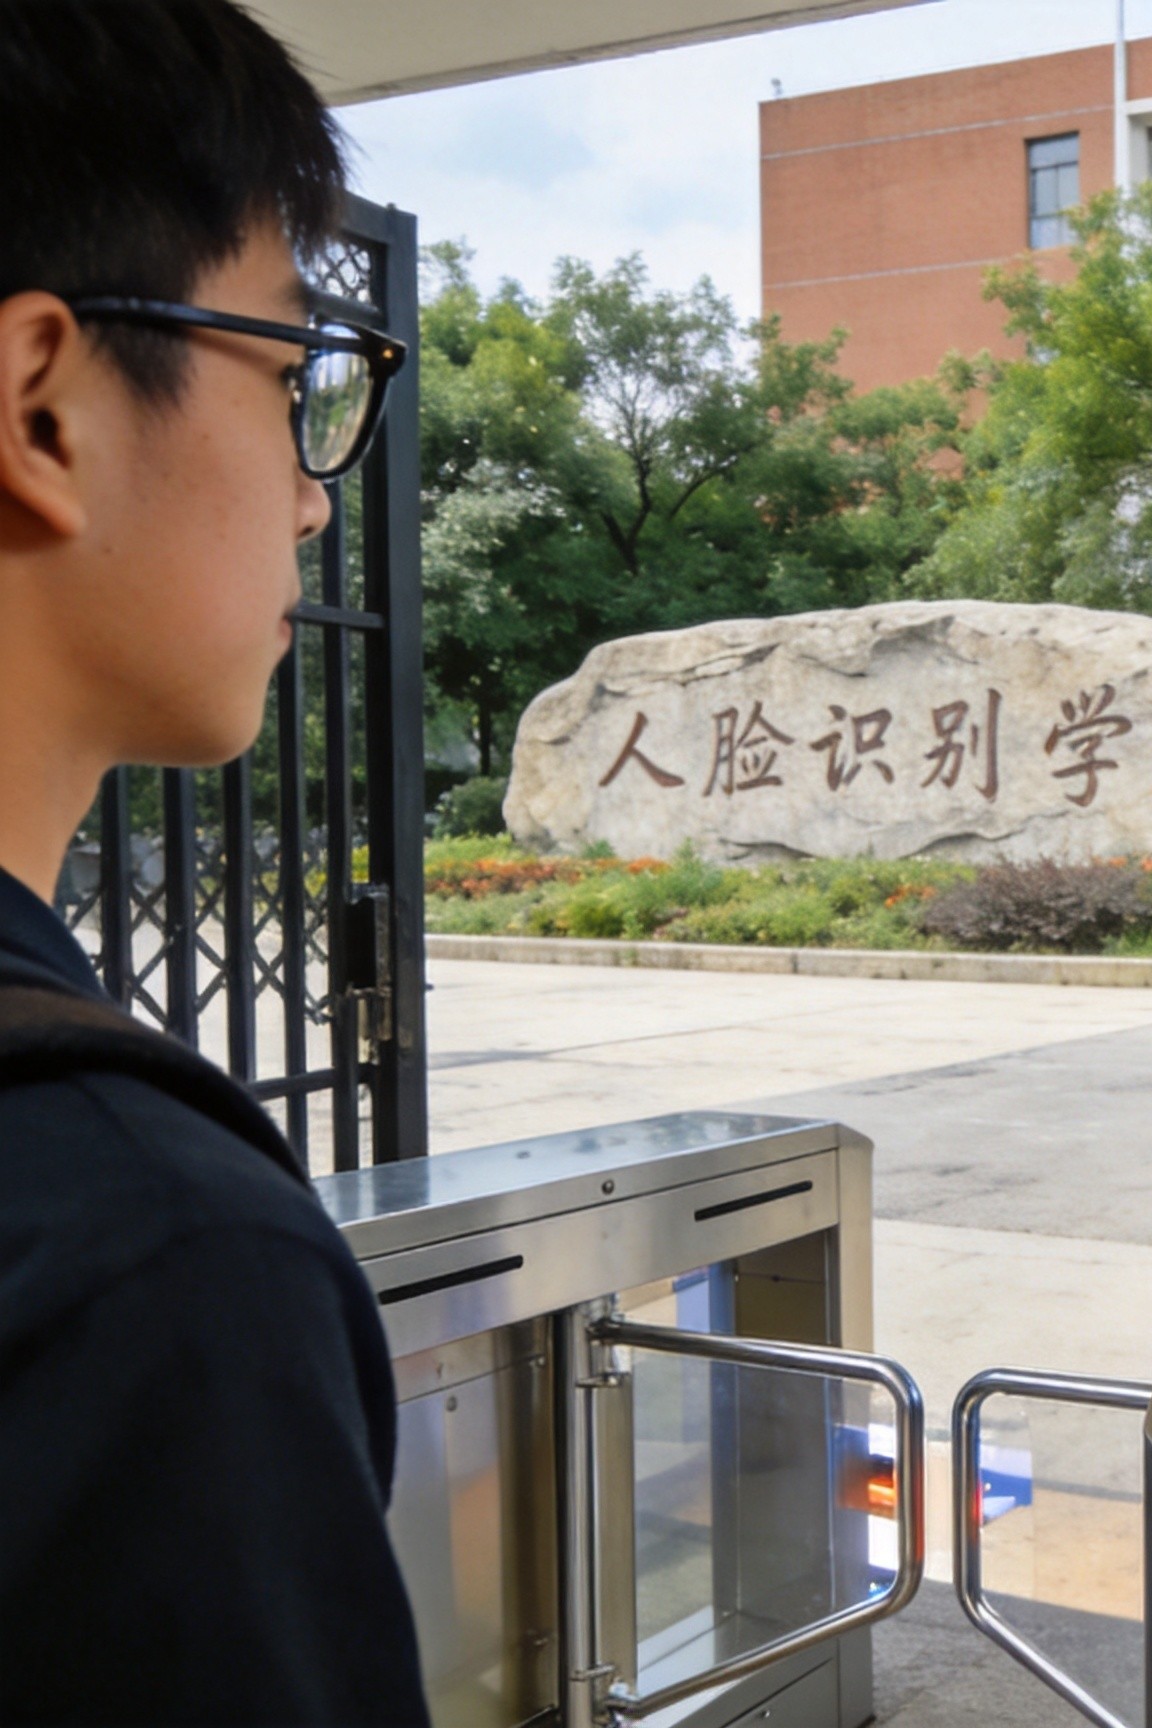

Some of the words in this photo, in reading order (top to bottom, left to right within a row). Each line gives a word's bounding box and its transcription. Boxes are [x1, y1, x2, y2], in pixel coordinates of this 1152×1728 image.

[598, 683, 1133, 807] 人脸识别学
